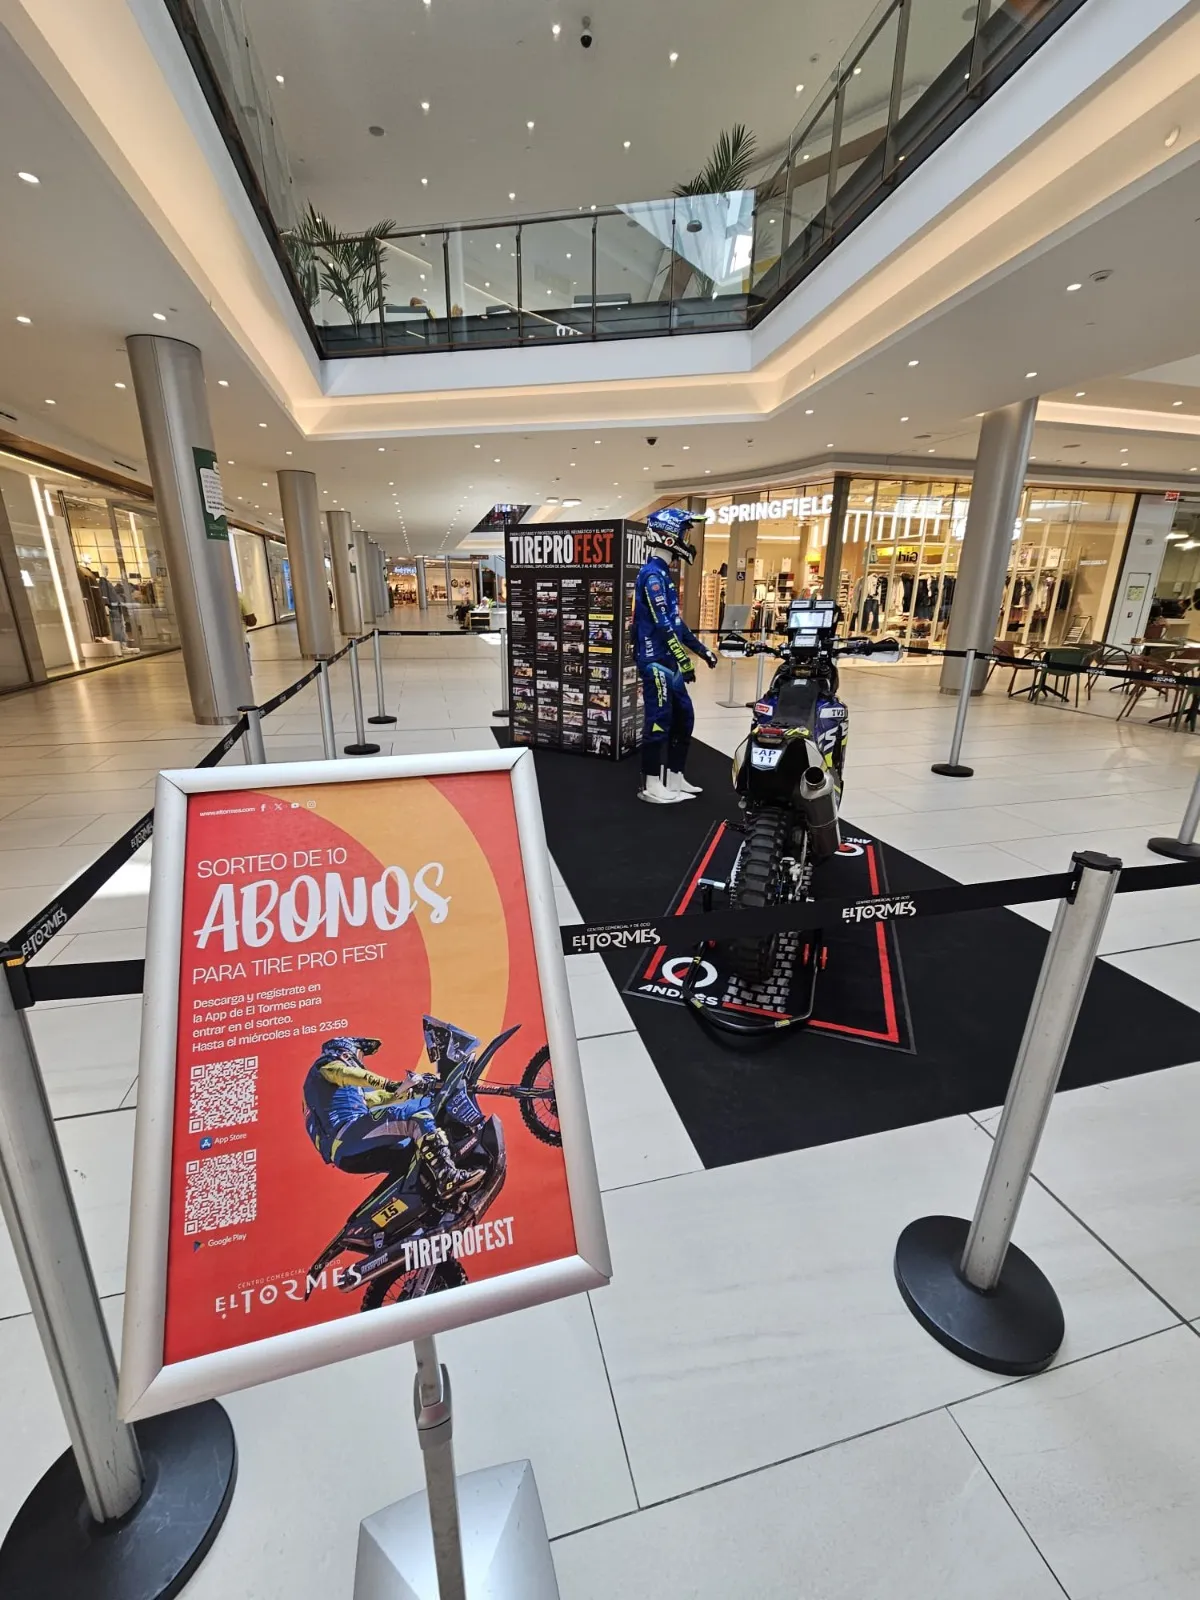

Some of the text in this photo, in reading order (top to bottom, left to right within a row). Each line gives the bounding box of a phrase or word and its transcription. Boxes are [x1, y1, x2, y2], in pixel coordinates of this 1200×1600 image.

[719, 494, 834, 524] SPRINGFIELD
[509, 532, 614, 564] TIREPROFEST
[197, 847, 347, 878] SORTEO DE 10
[193, 862, 452, 953] ABONOS
[192, 943, 388, 985] PARA TIRE PRO FEST
[193, 983, 321, 1009] Descarga y regístrate en
[638, 984, 718, 1006] ANDES
[193, 997, 322, 1023] la App de El Tormes para
[192, 1015, 293, 1038] entrar en el sorteo.
[192, 1019, 348, 1053] Hasta el miércoles a las 23:59
[214, 1133, 247, 1144] App Store
[380, 1205, 399, 1222] 15
[207, 1232, 247, 1247] Google Play
[400, 1217, 514, 1272] TIREPROFEST
[237, 1278, 265, 1289] CENTRO
[266, 1268, 306, 1283] COMERCIAL
